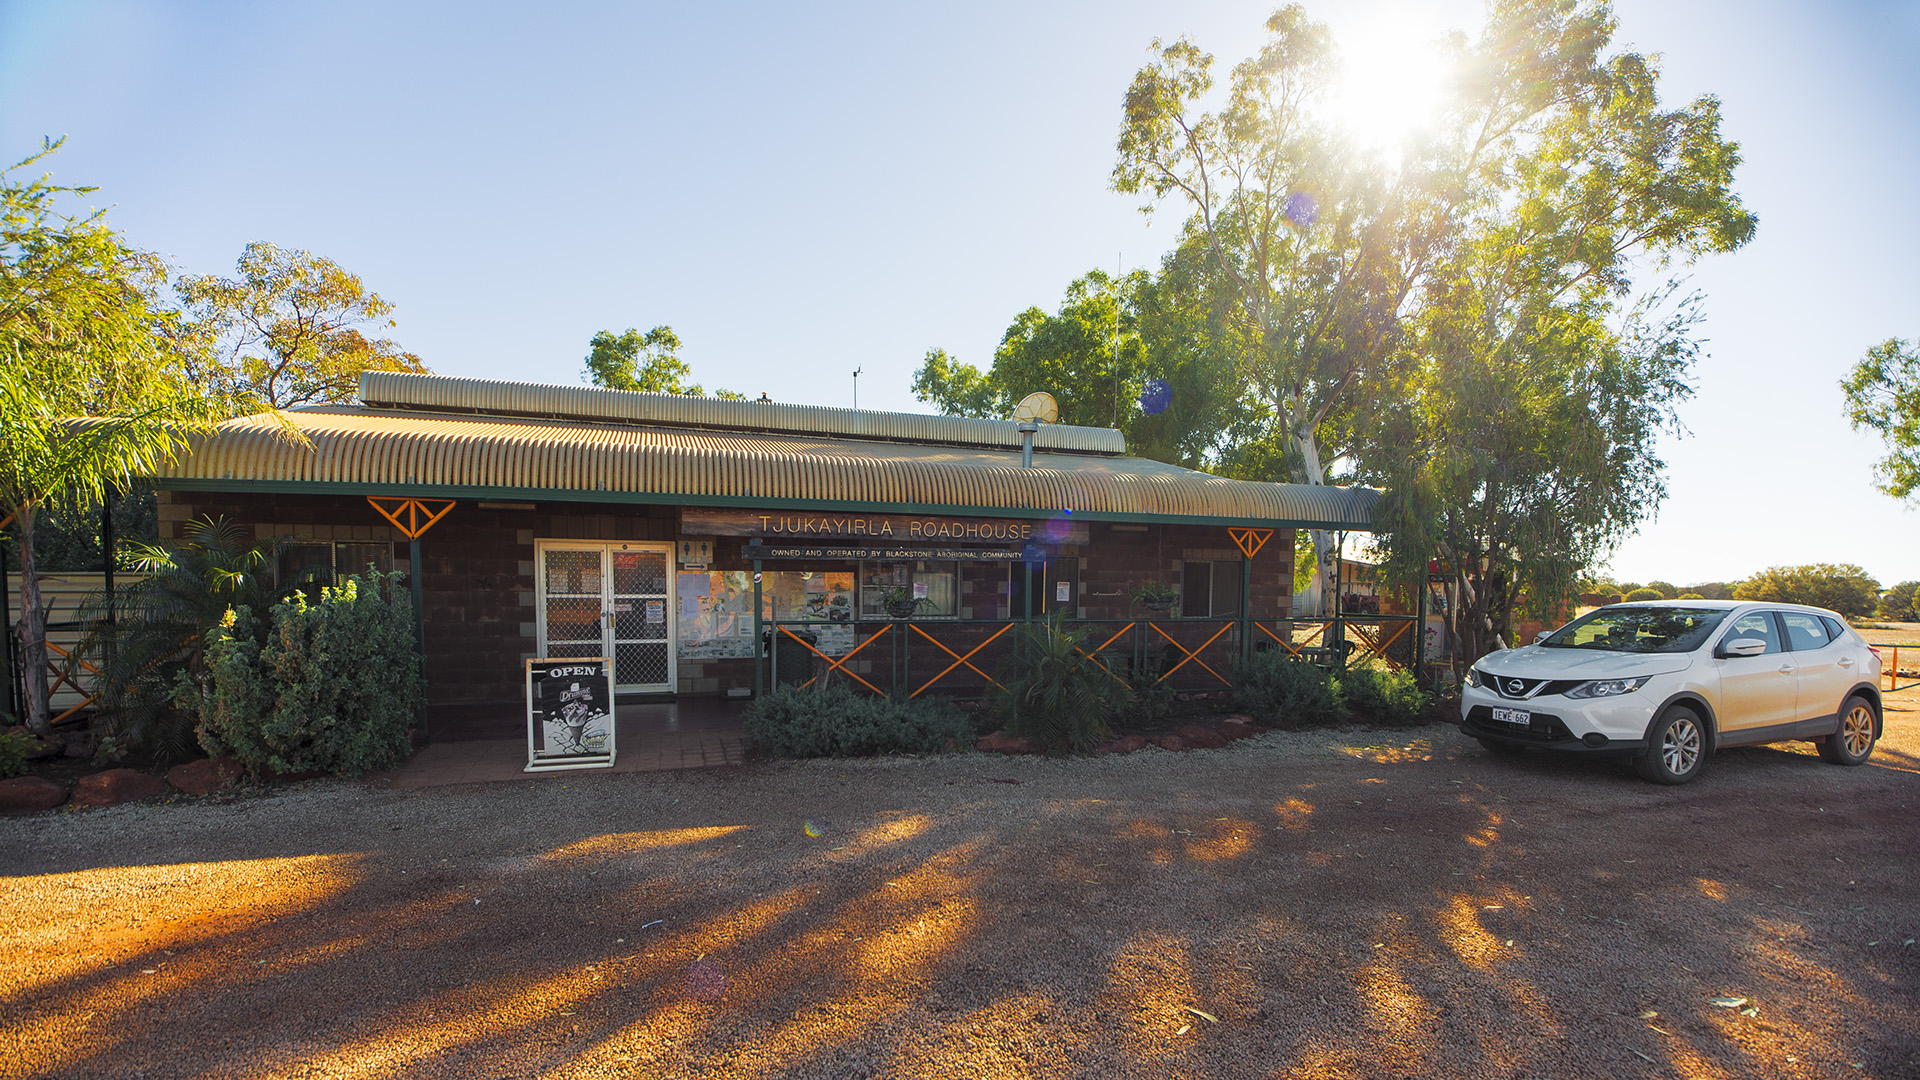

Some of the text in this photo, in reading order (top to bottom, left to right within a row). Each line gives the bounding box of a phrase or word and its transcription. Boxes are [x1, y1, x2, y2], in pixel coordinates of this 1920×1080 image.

[759, 516, 1031, 539] TJUKAYIRLA ROADHOUSE
[771, 549, 801, 557] OWNED
[805, 549, 822, 557] AND
[827, 549, 867, 558] OPERATED
[885, 550, 932, 558] BLACKSTONE
[937, 551, 978, 559] ABORIGINAL
[982, 551, 1023, 559] COMMUNITY
[550, 666, 597, 678] OPEN
[1495, 711, 1528, 724] 1EWE 662
